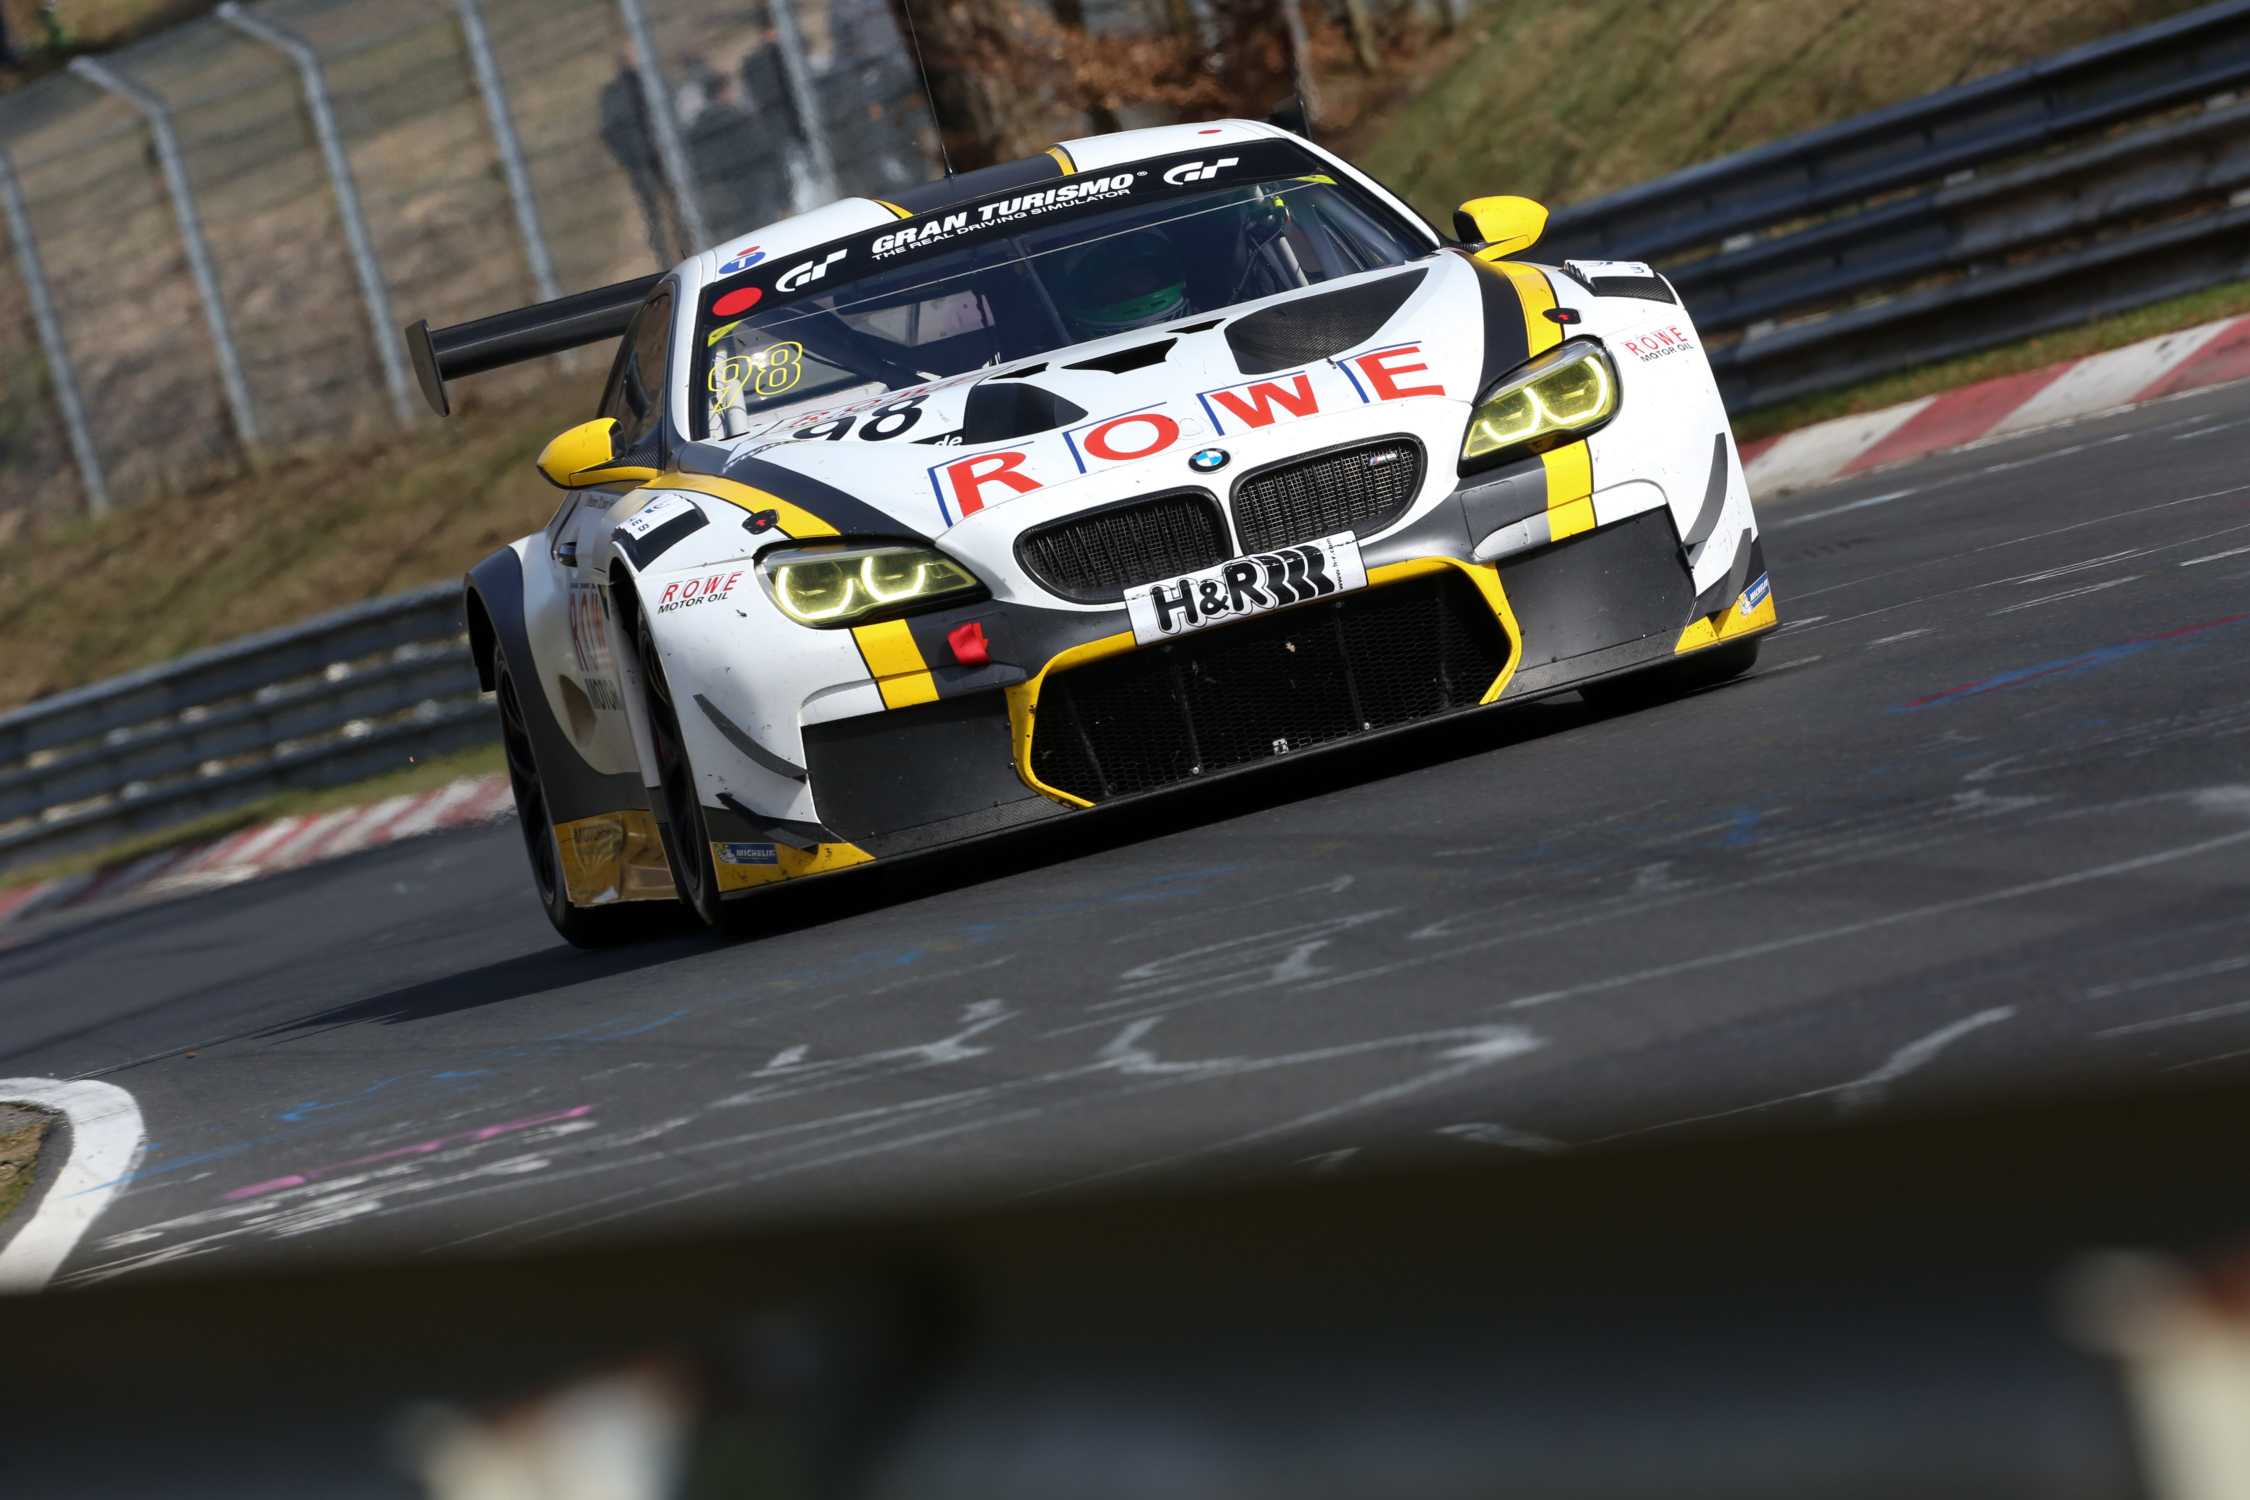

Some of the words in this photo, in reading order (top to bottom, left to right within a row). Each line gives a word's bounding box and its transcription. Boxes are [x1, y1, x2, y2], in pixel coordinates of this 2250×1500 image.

[871, 211, 968, 255] GRAN
[976, 172, 1135, 222] TURISMO
[872, 246, 907, 261] THE
[910, 233, 953, 249] REAL
[955, 211, 1027, 234] DRIVING
[1030, 188, 1131, 216] SIMULATOR
[1624, 326, 1689, 356] ROWE
[1640, 346, 1677, 363] MOTOR
[1677, 342, 1695, 352] OIL
[708, 341, 804, 414] 98
[793, 394, 930, 442] 98
[944, 345, 1447, 519] ROWE
[658, 596, 705, 615] MOTOR
[707, 591, 729, 603] OIL
[660, 572, 743, 604] ROWE
[1150, 556, 1284, 634] H&R
